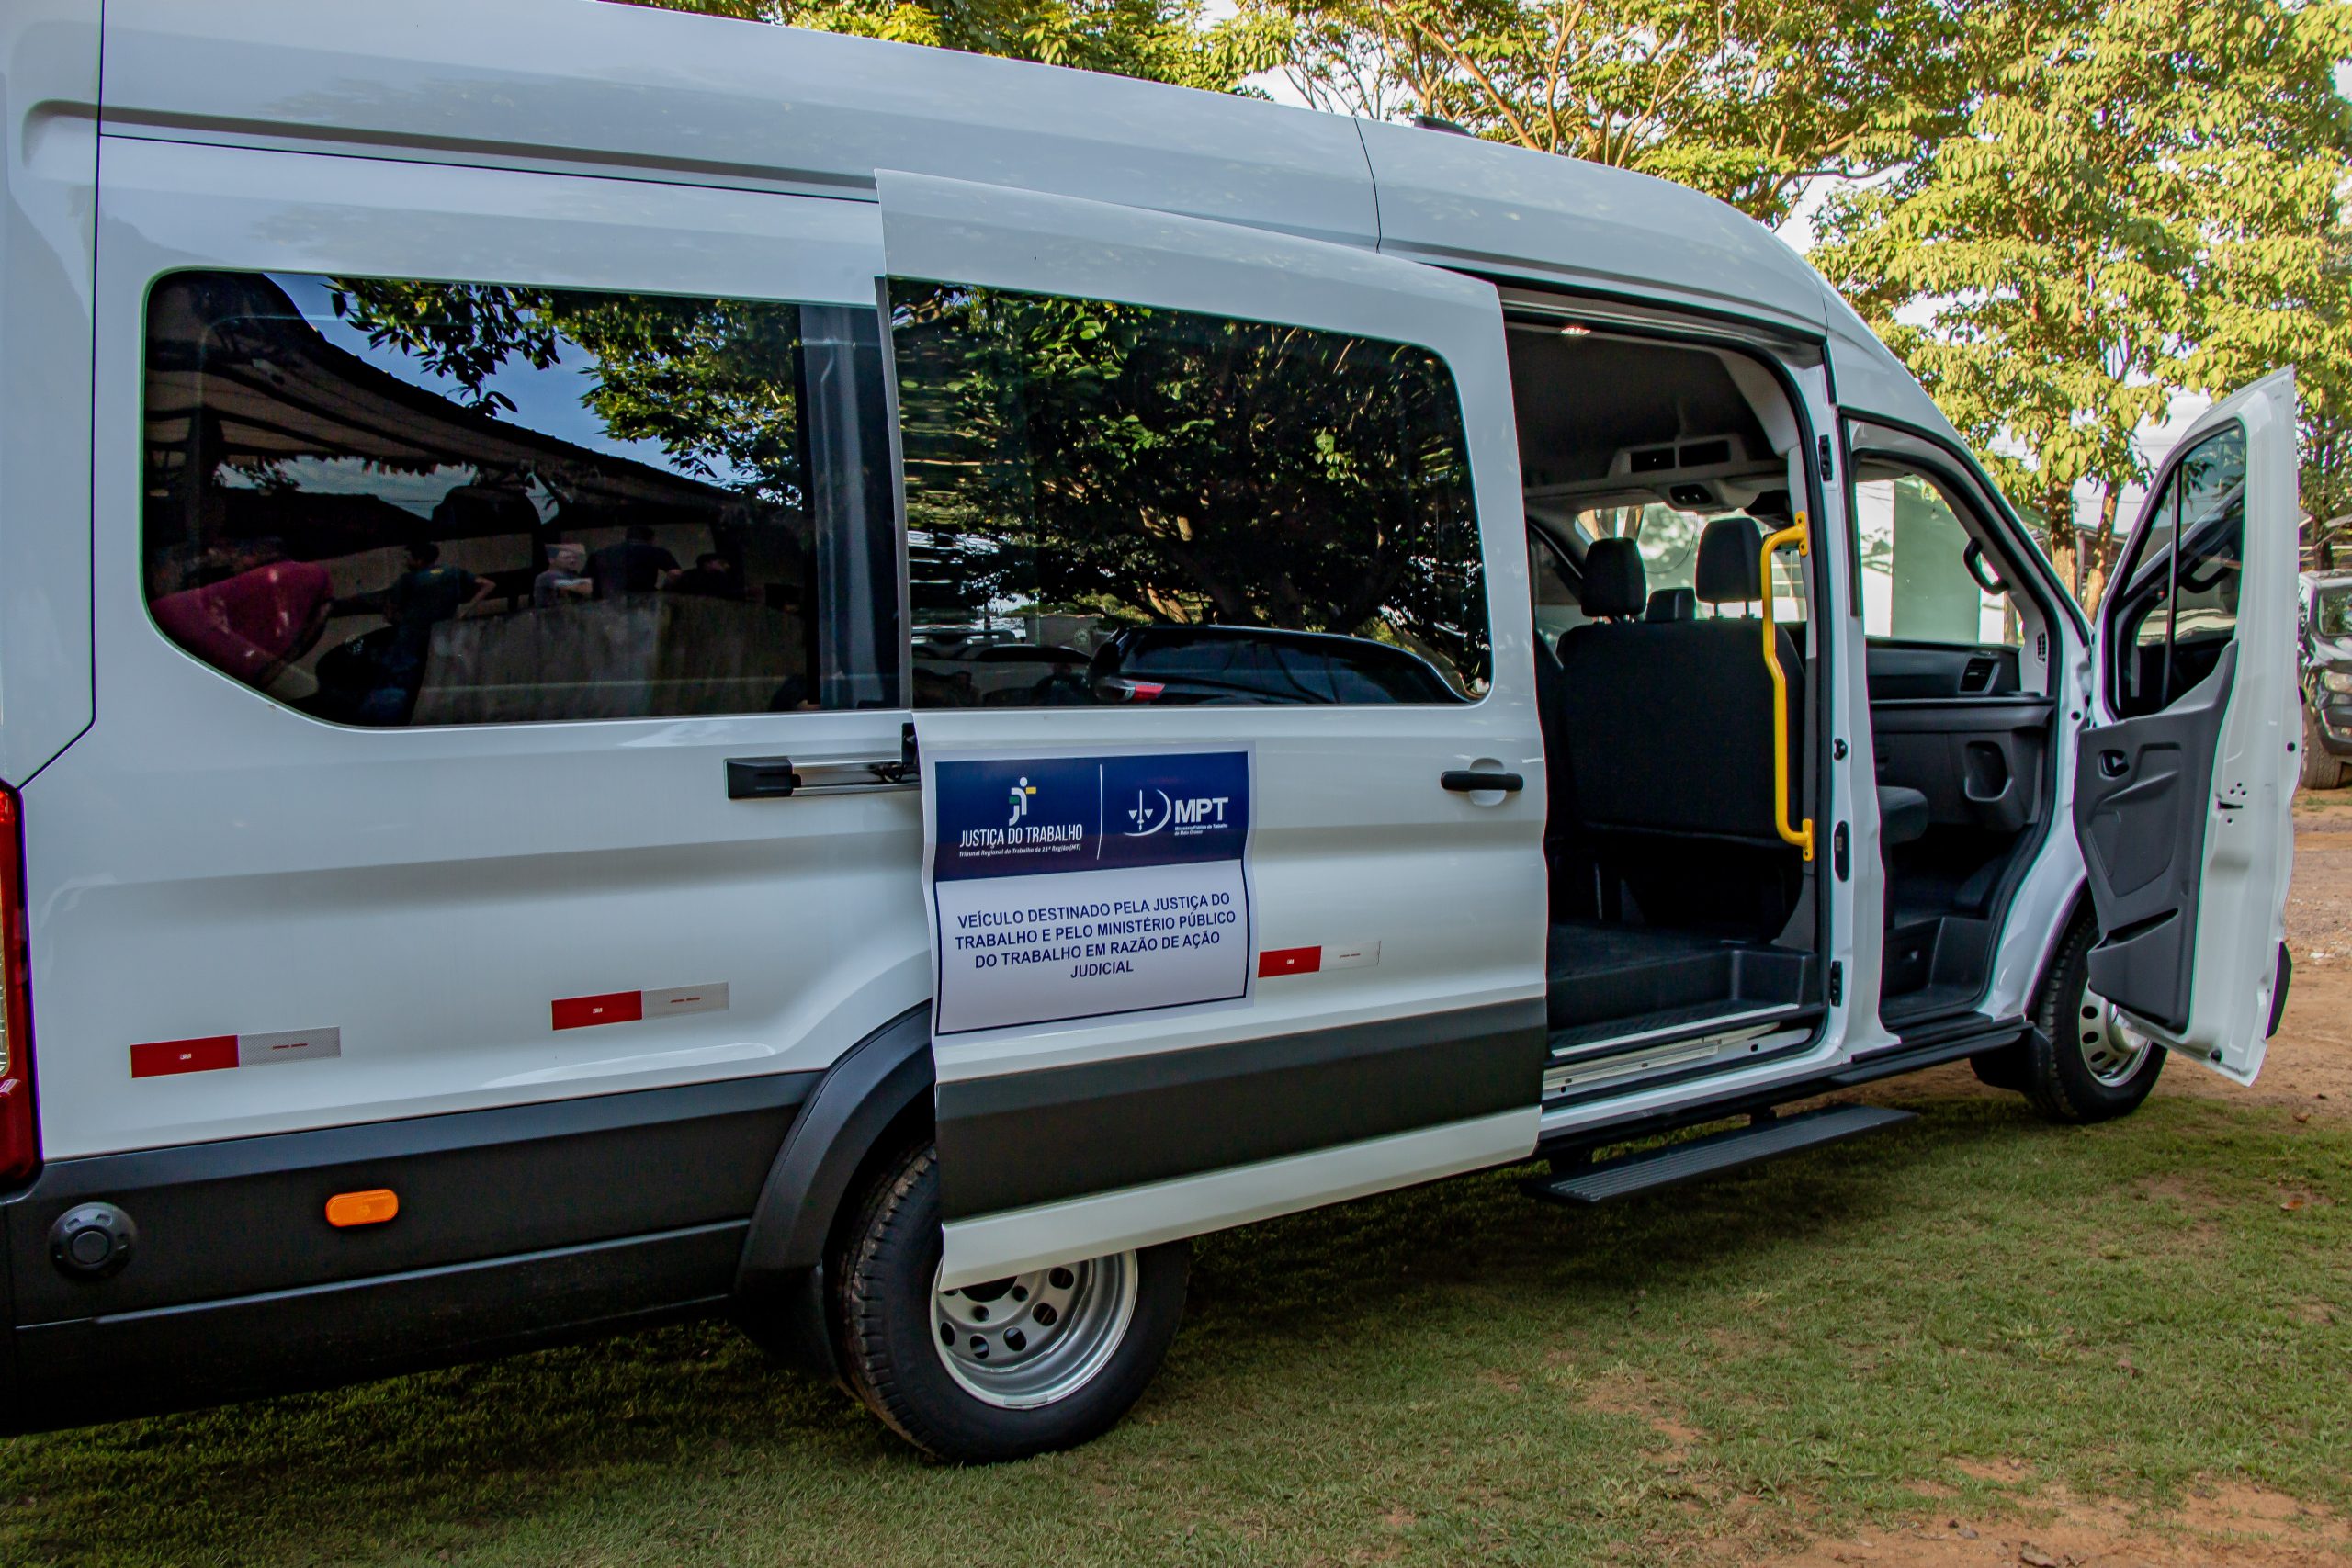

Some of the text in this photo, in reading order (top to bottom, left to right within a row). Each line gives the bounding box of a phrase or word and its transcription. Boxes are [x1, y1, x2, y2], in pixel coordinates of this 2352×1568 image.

[1175, 796, 1229, 823] MPT
[960, 824, 1082, 849] JUSTIÇA DO TRABALHO
[957, 892, 1230, 929] VEÍCULO DESTINADO PELA JUSTIÇA DO
[955, 910, 1236, 950] TRABALHO E PELO MINISTÉRIO PÚBLICO
[975, 930, 1220, 969] DO TRABALHO EM RAZÃO DE AÇÃO
[1070, 960, 1134, 978] JUDICIAL
